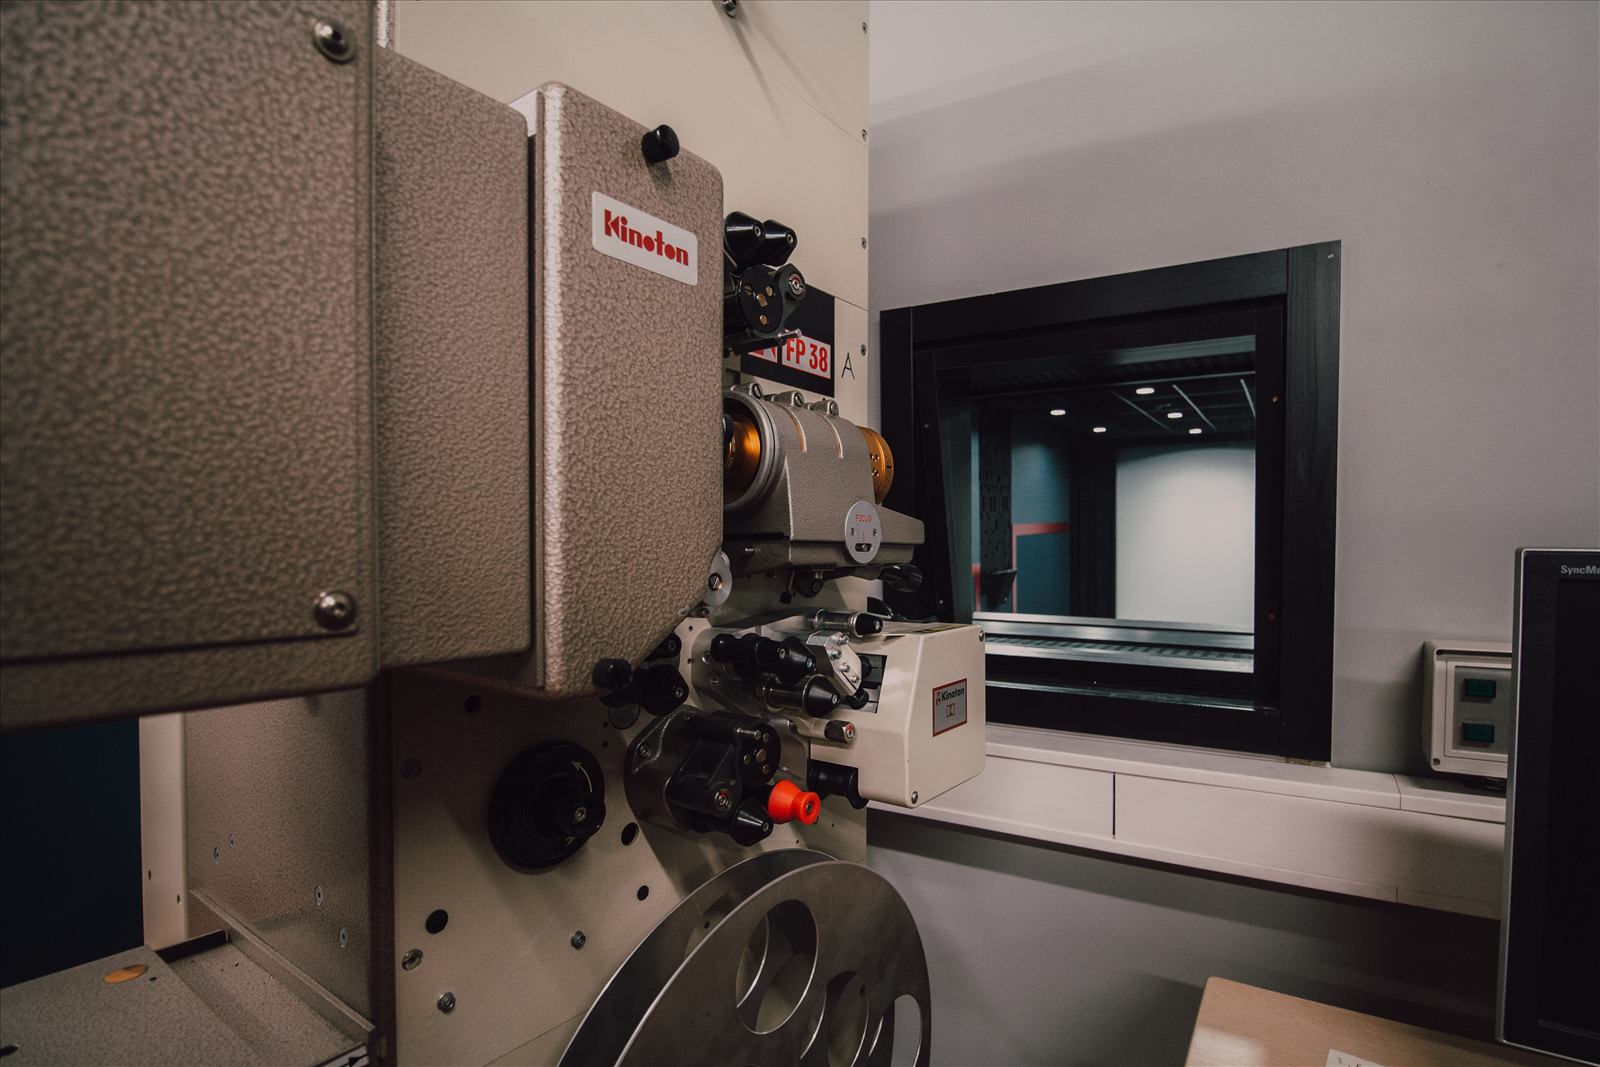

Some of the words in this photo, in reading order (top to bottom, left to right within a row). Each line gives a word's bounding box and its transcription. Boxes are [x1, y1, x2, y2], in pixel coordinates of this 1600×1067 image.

[604, 208, 689, 267] Kinoton
[786, 337, 806, 365] FP
[809, 343, 828, 373] 38
[841, 352, 855, 380] A
[855, 514, 872, 523] FOCUS
[941, 687, 965, 702] Kinoton
